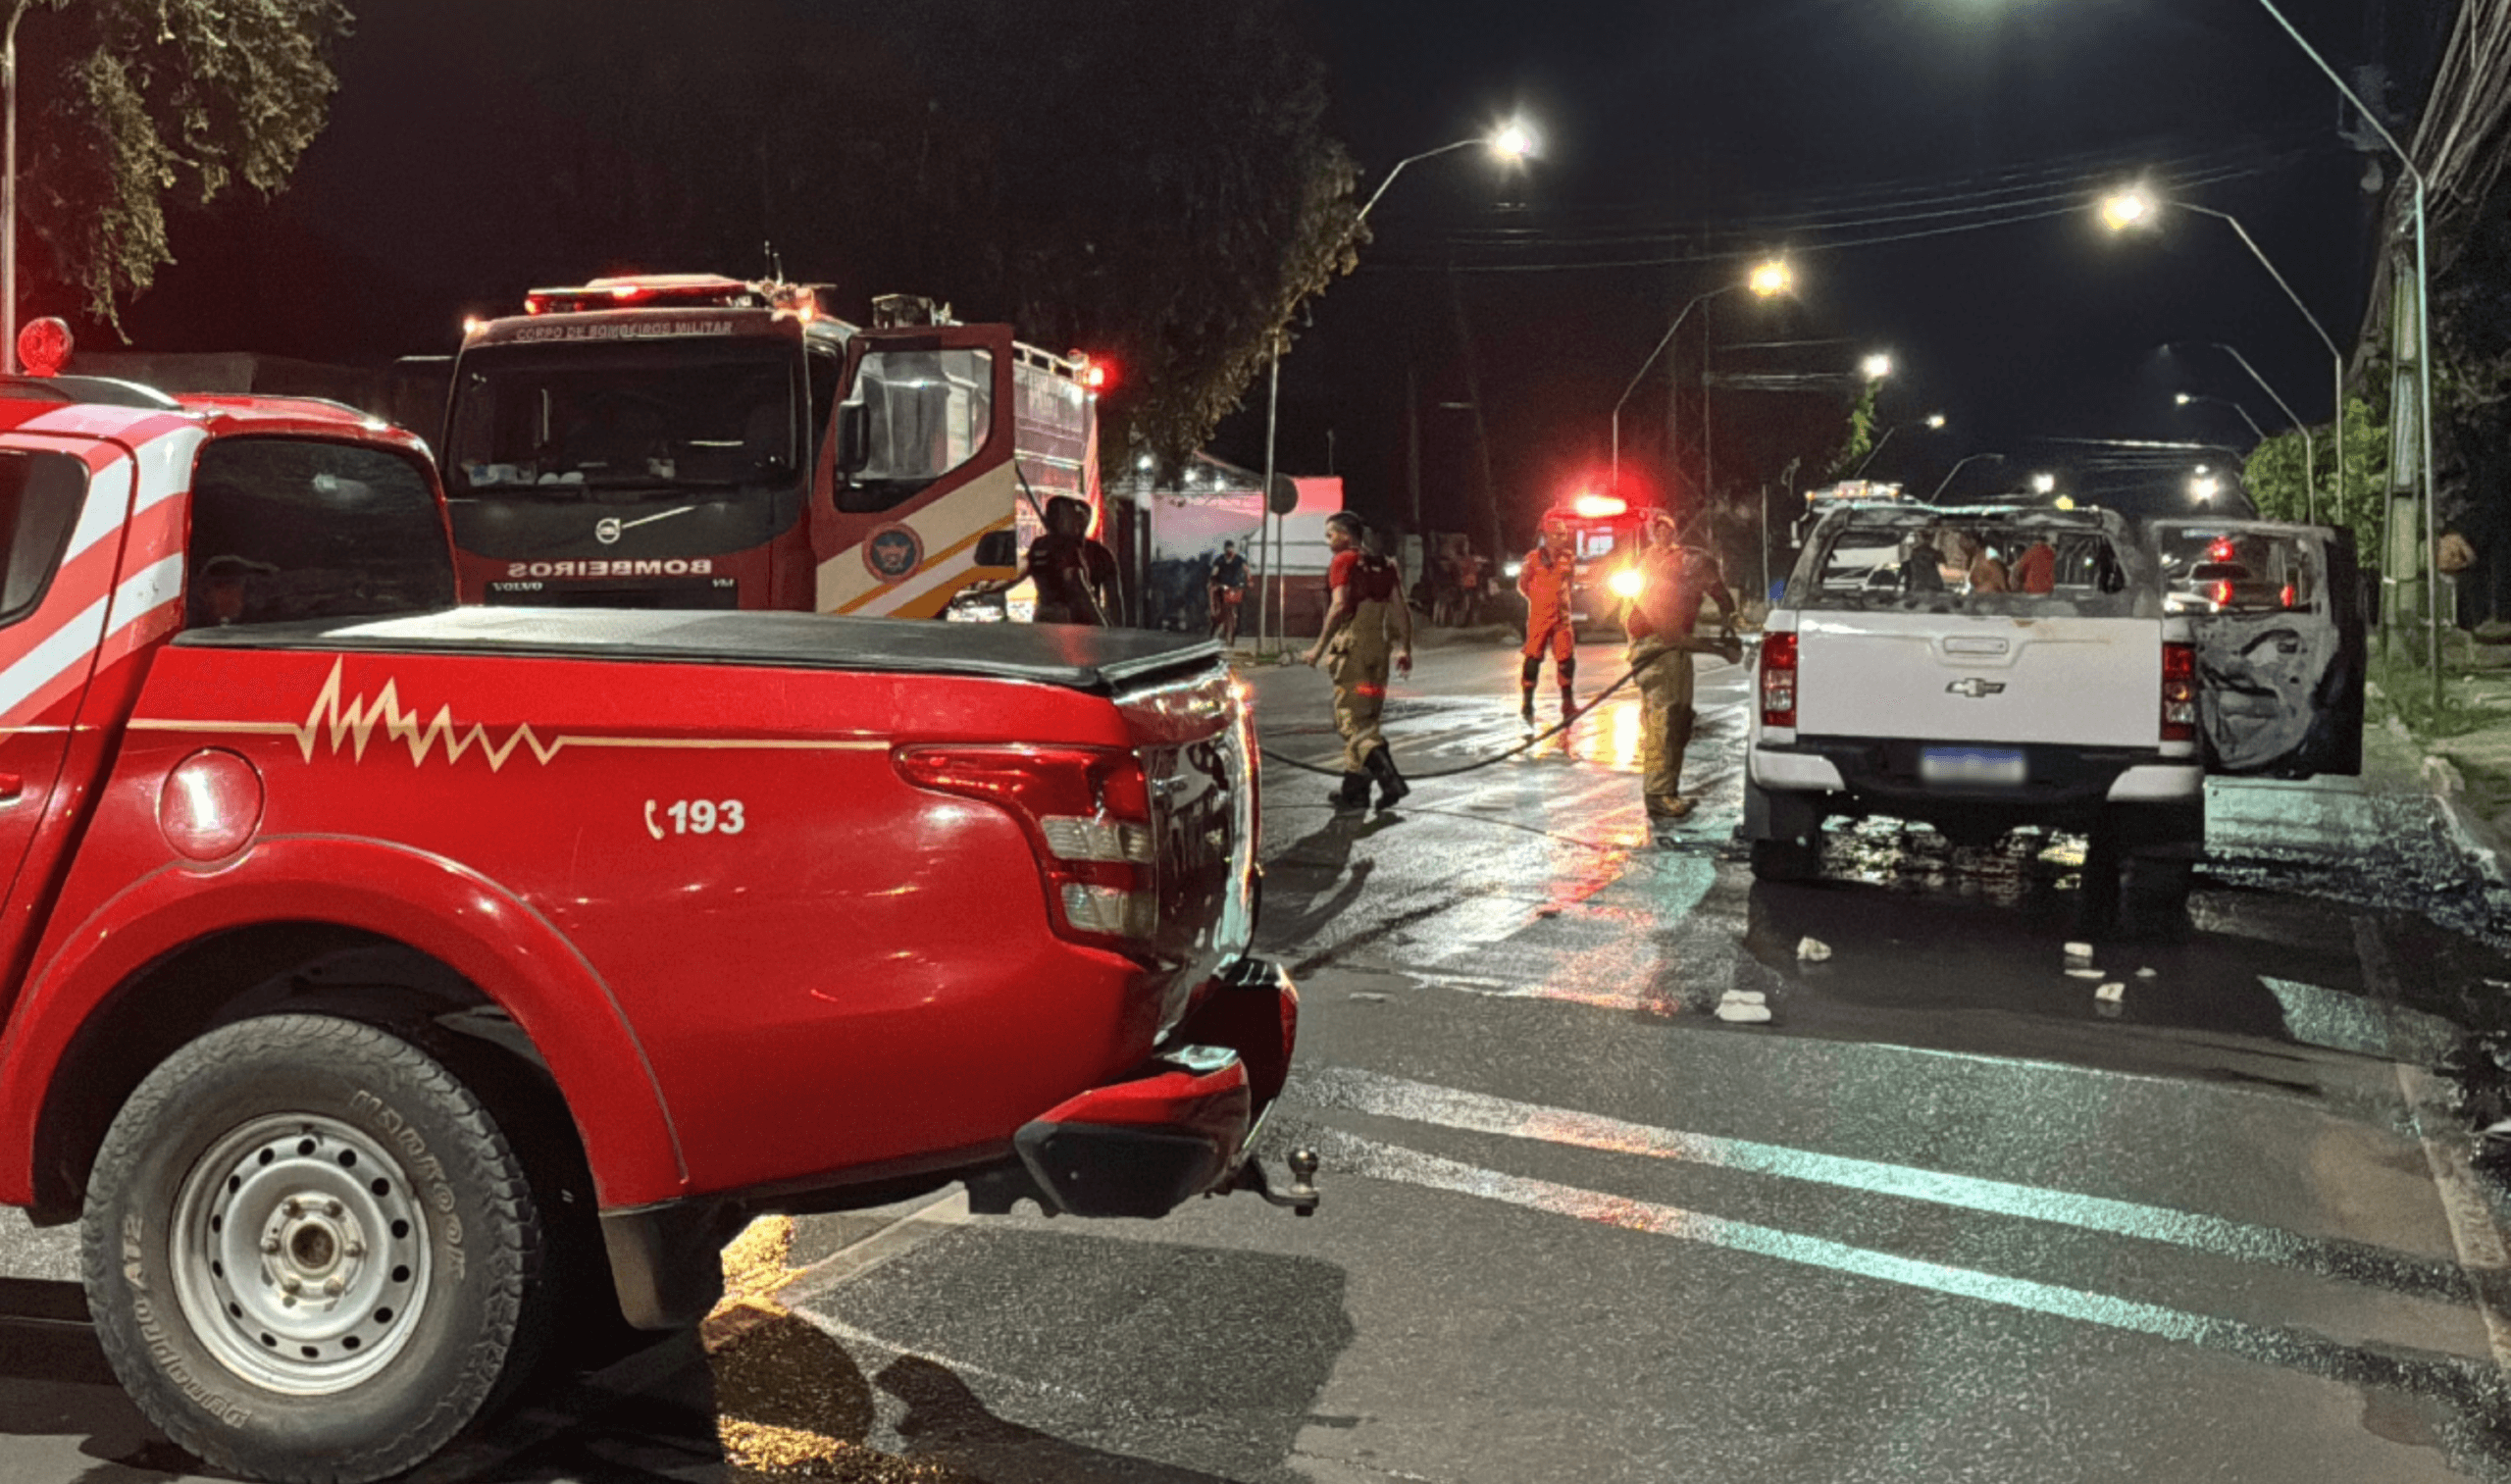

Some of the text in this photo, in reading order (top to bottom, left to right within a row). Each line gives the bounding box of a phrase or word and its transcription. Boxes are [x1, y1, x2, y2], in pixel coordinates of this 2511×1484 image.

[516, 321, 734, 340] CORPO DE BOMBEIROS MILITAR
[491, 582, 543, 591] VOLVO
[667, 798, 745, 835] 193
[123, 1214, 147, 1290] AT2
